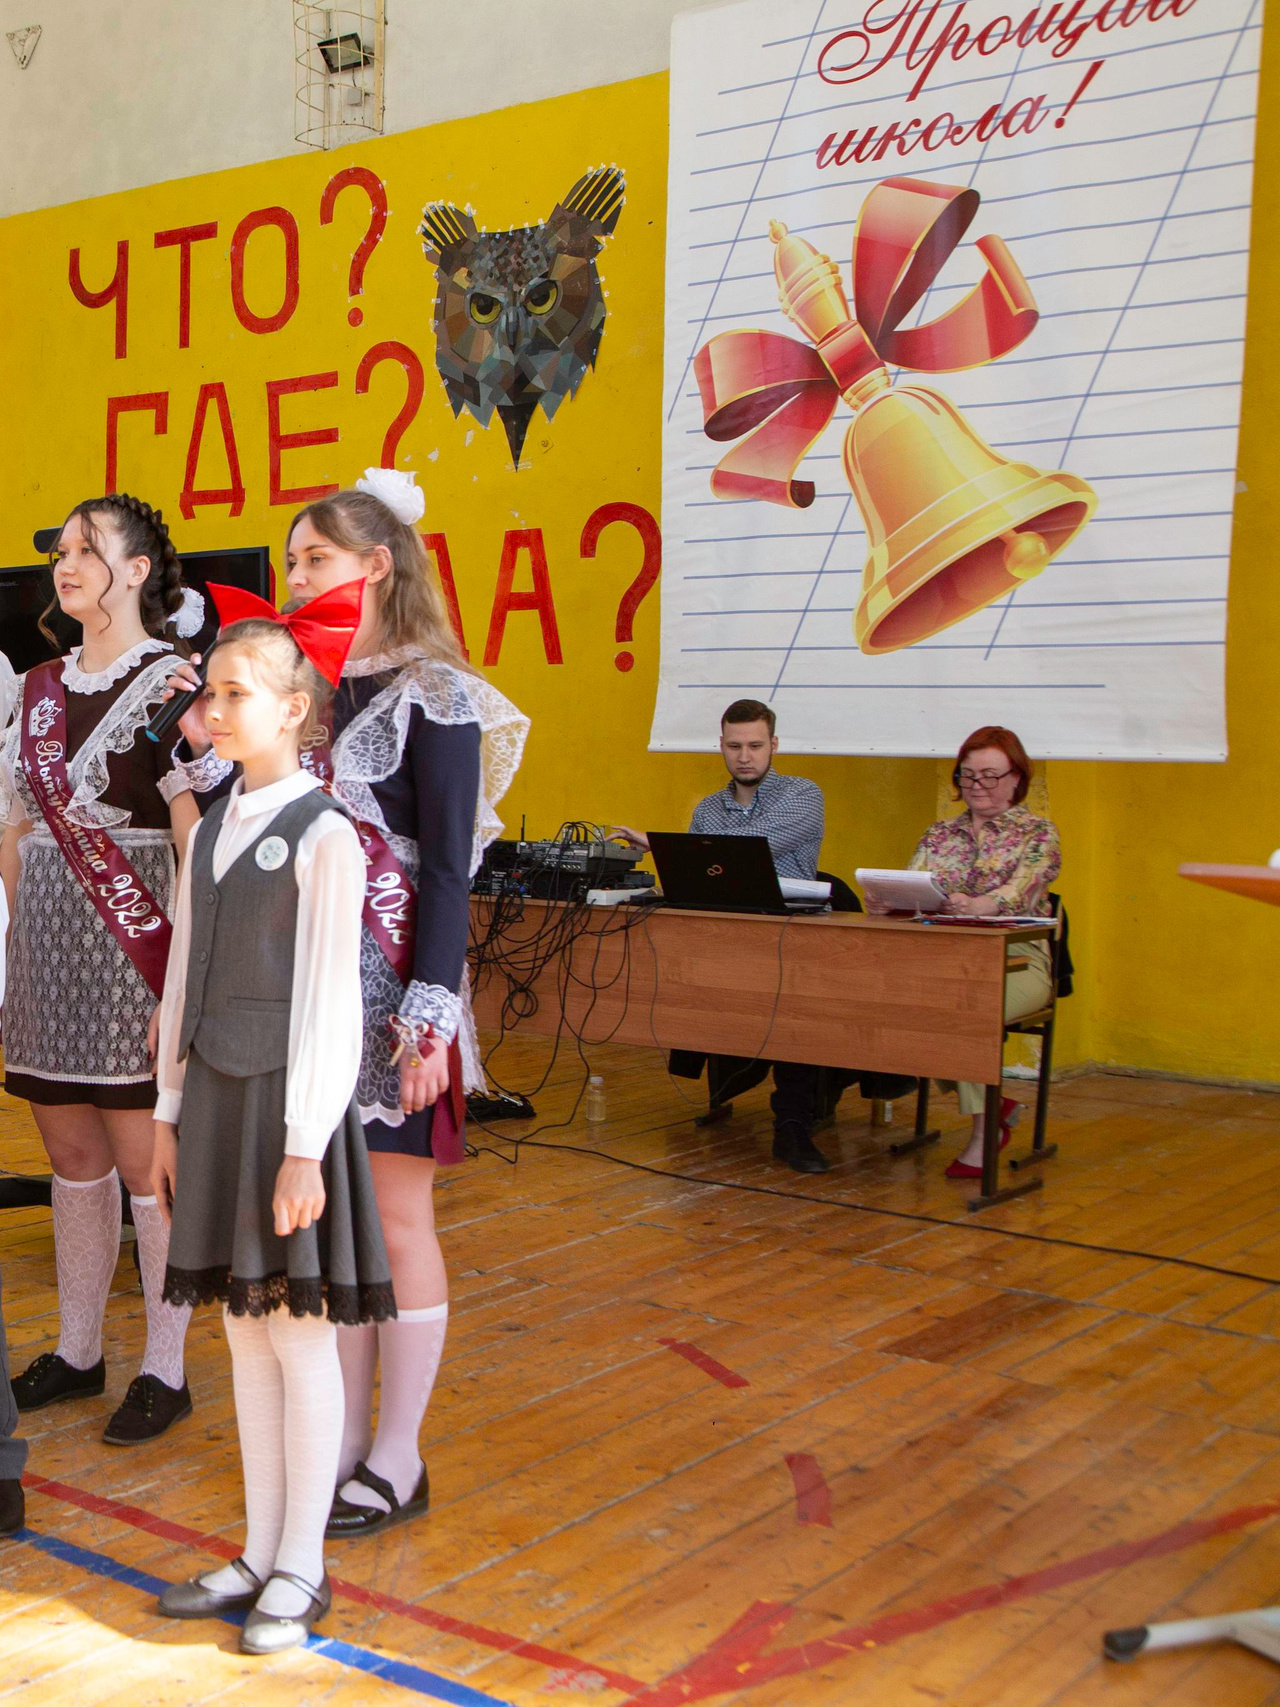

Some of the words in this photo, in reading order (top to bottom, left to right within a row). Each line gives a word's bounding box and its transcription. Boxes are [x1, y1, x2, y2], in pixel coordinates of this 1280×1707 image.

[815, 59, 1106, 170] школа!
[68, 166, 388, 359] ЧТО?
[105, 340, 424, 520] ГДЕ?
[96, 873, 162, 939] 2022
